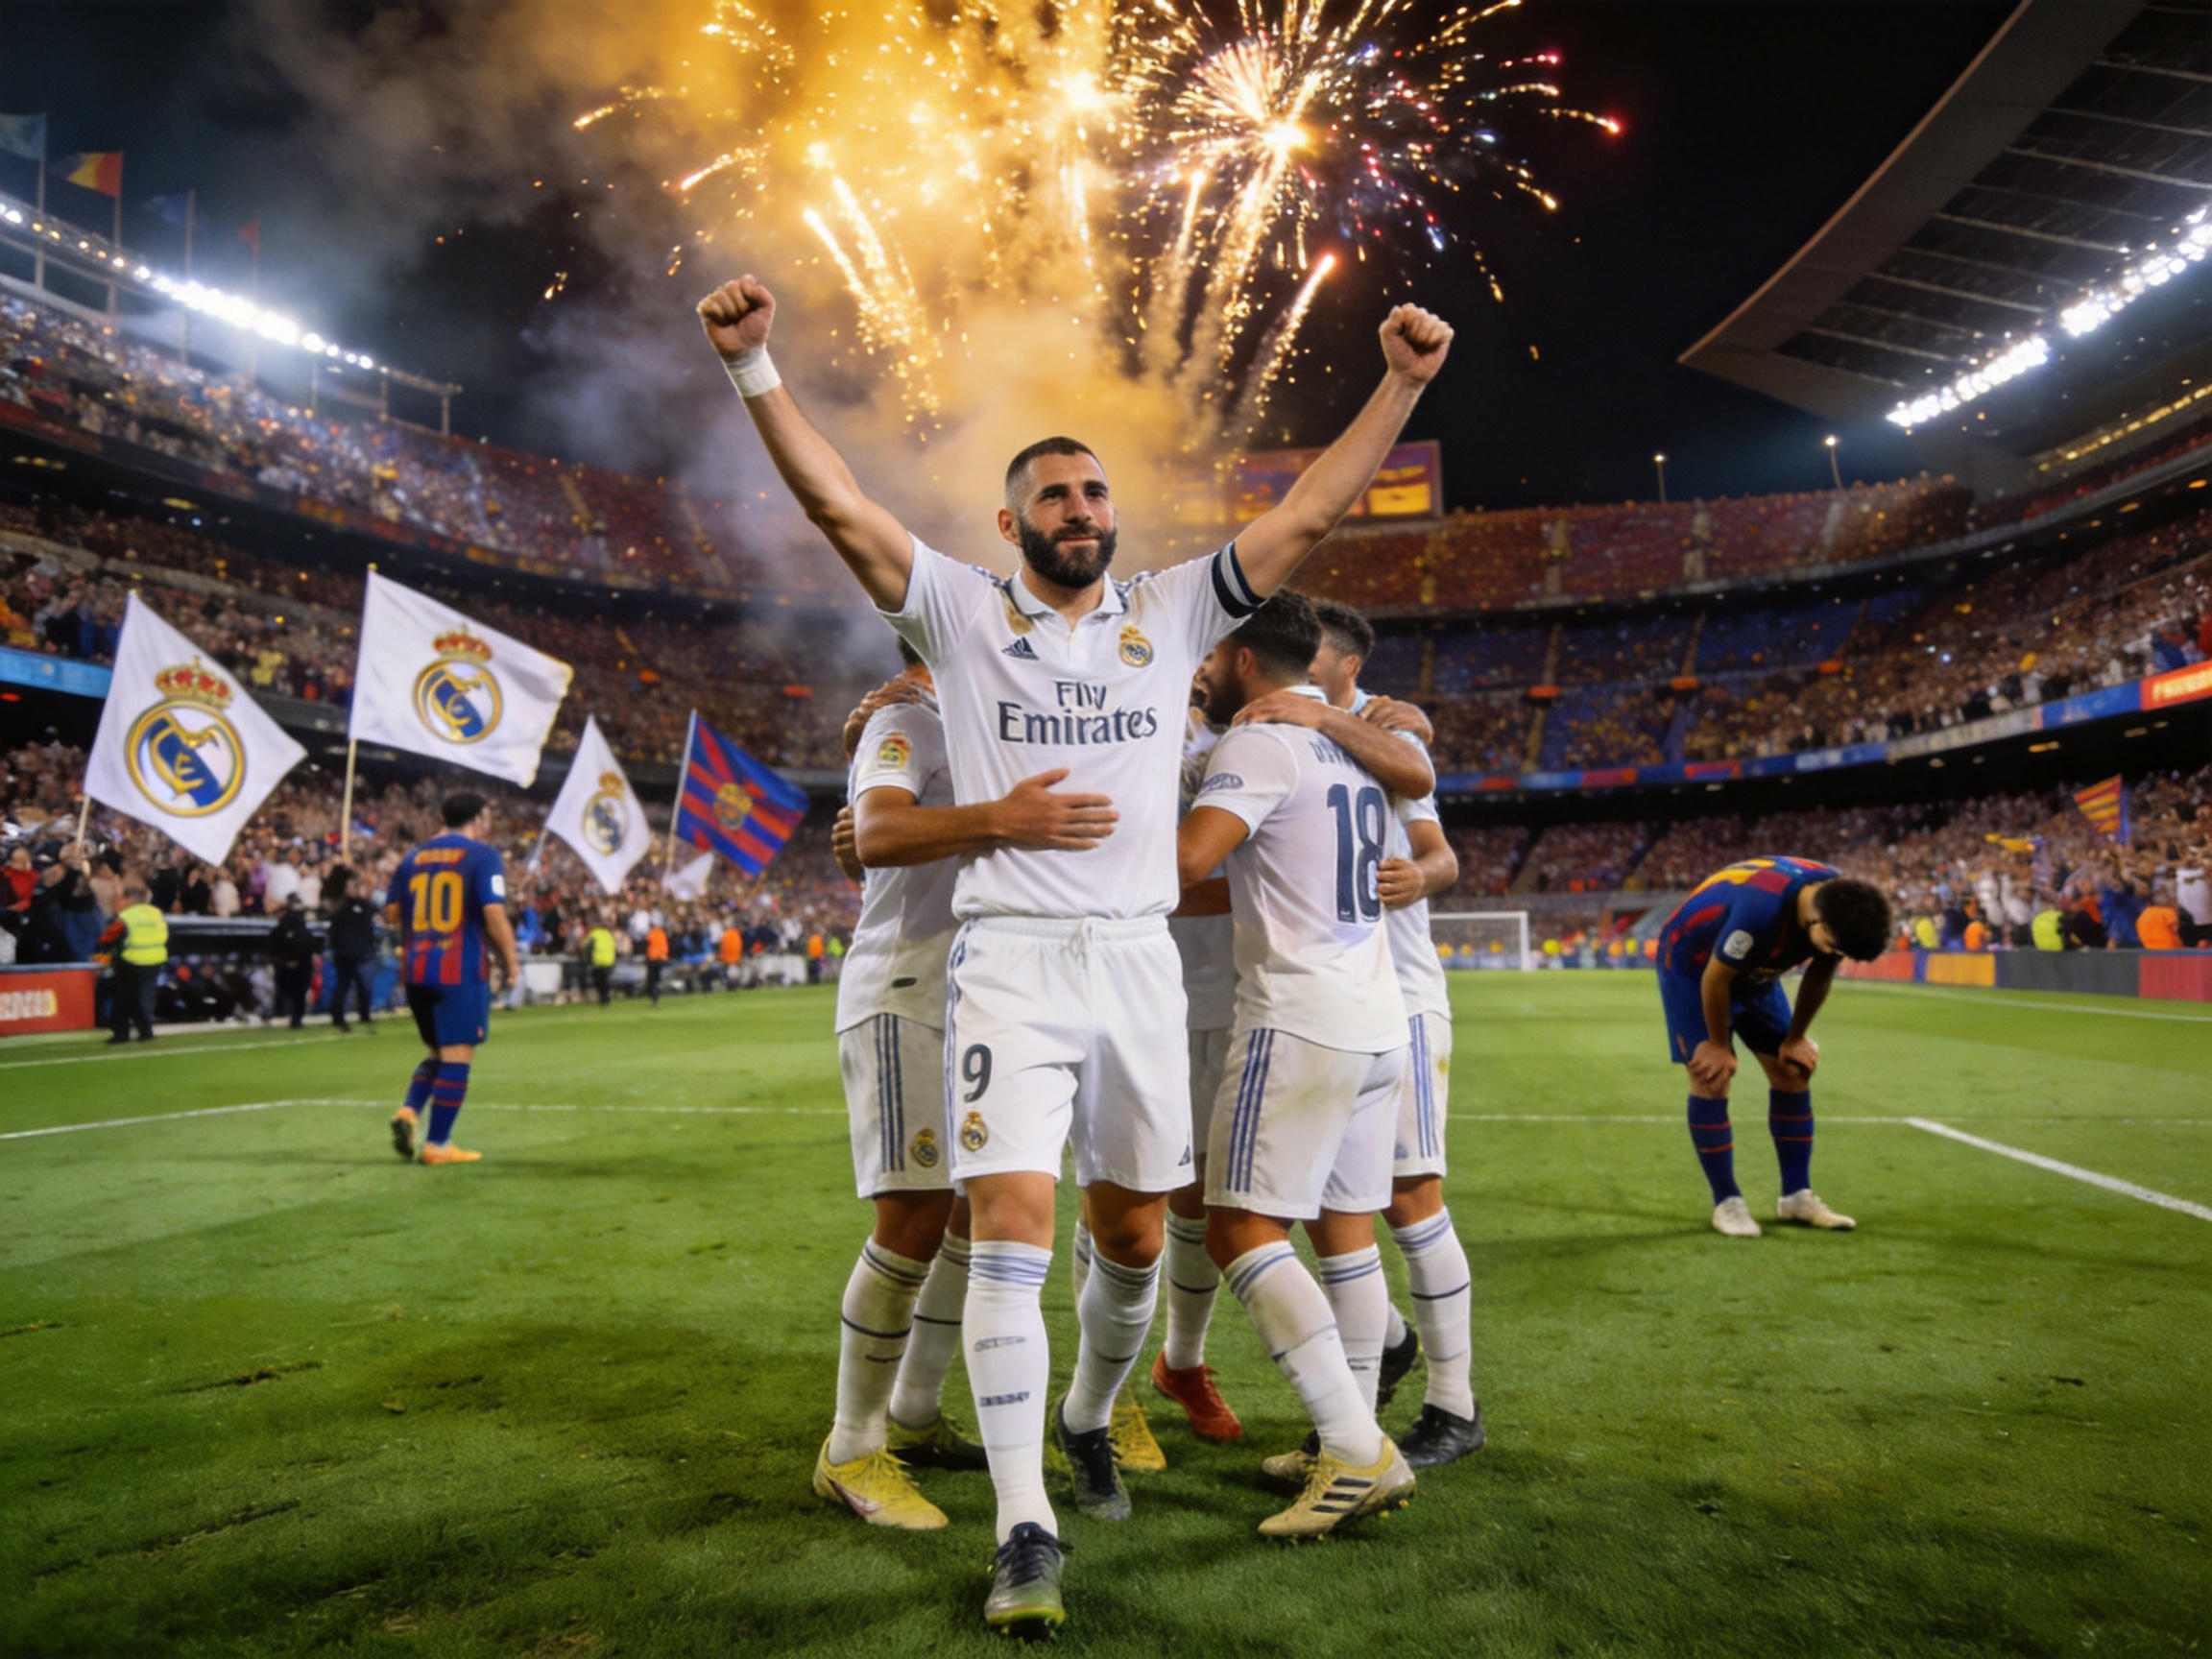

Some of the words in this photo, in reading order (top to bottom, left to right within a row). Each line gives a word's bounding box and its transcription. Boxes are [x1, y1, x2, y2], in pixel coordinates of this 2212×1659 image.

[997, 701, 1158, 745] Emirates
[1327, 782, 1385, 923] 18
[409, 870, 464, 933] 10
[962, 1043, 993, 1103] 9
